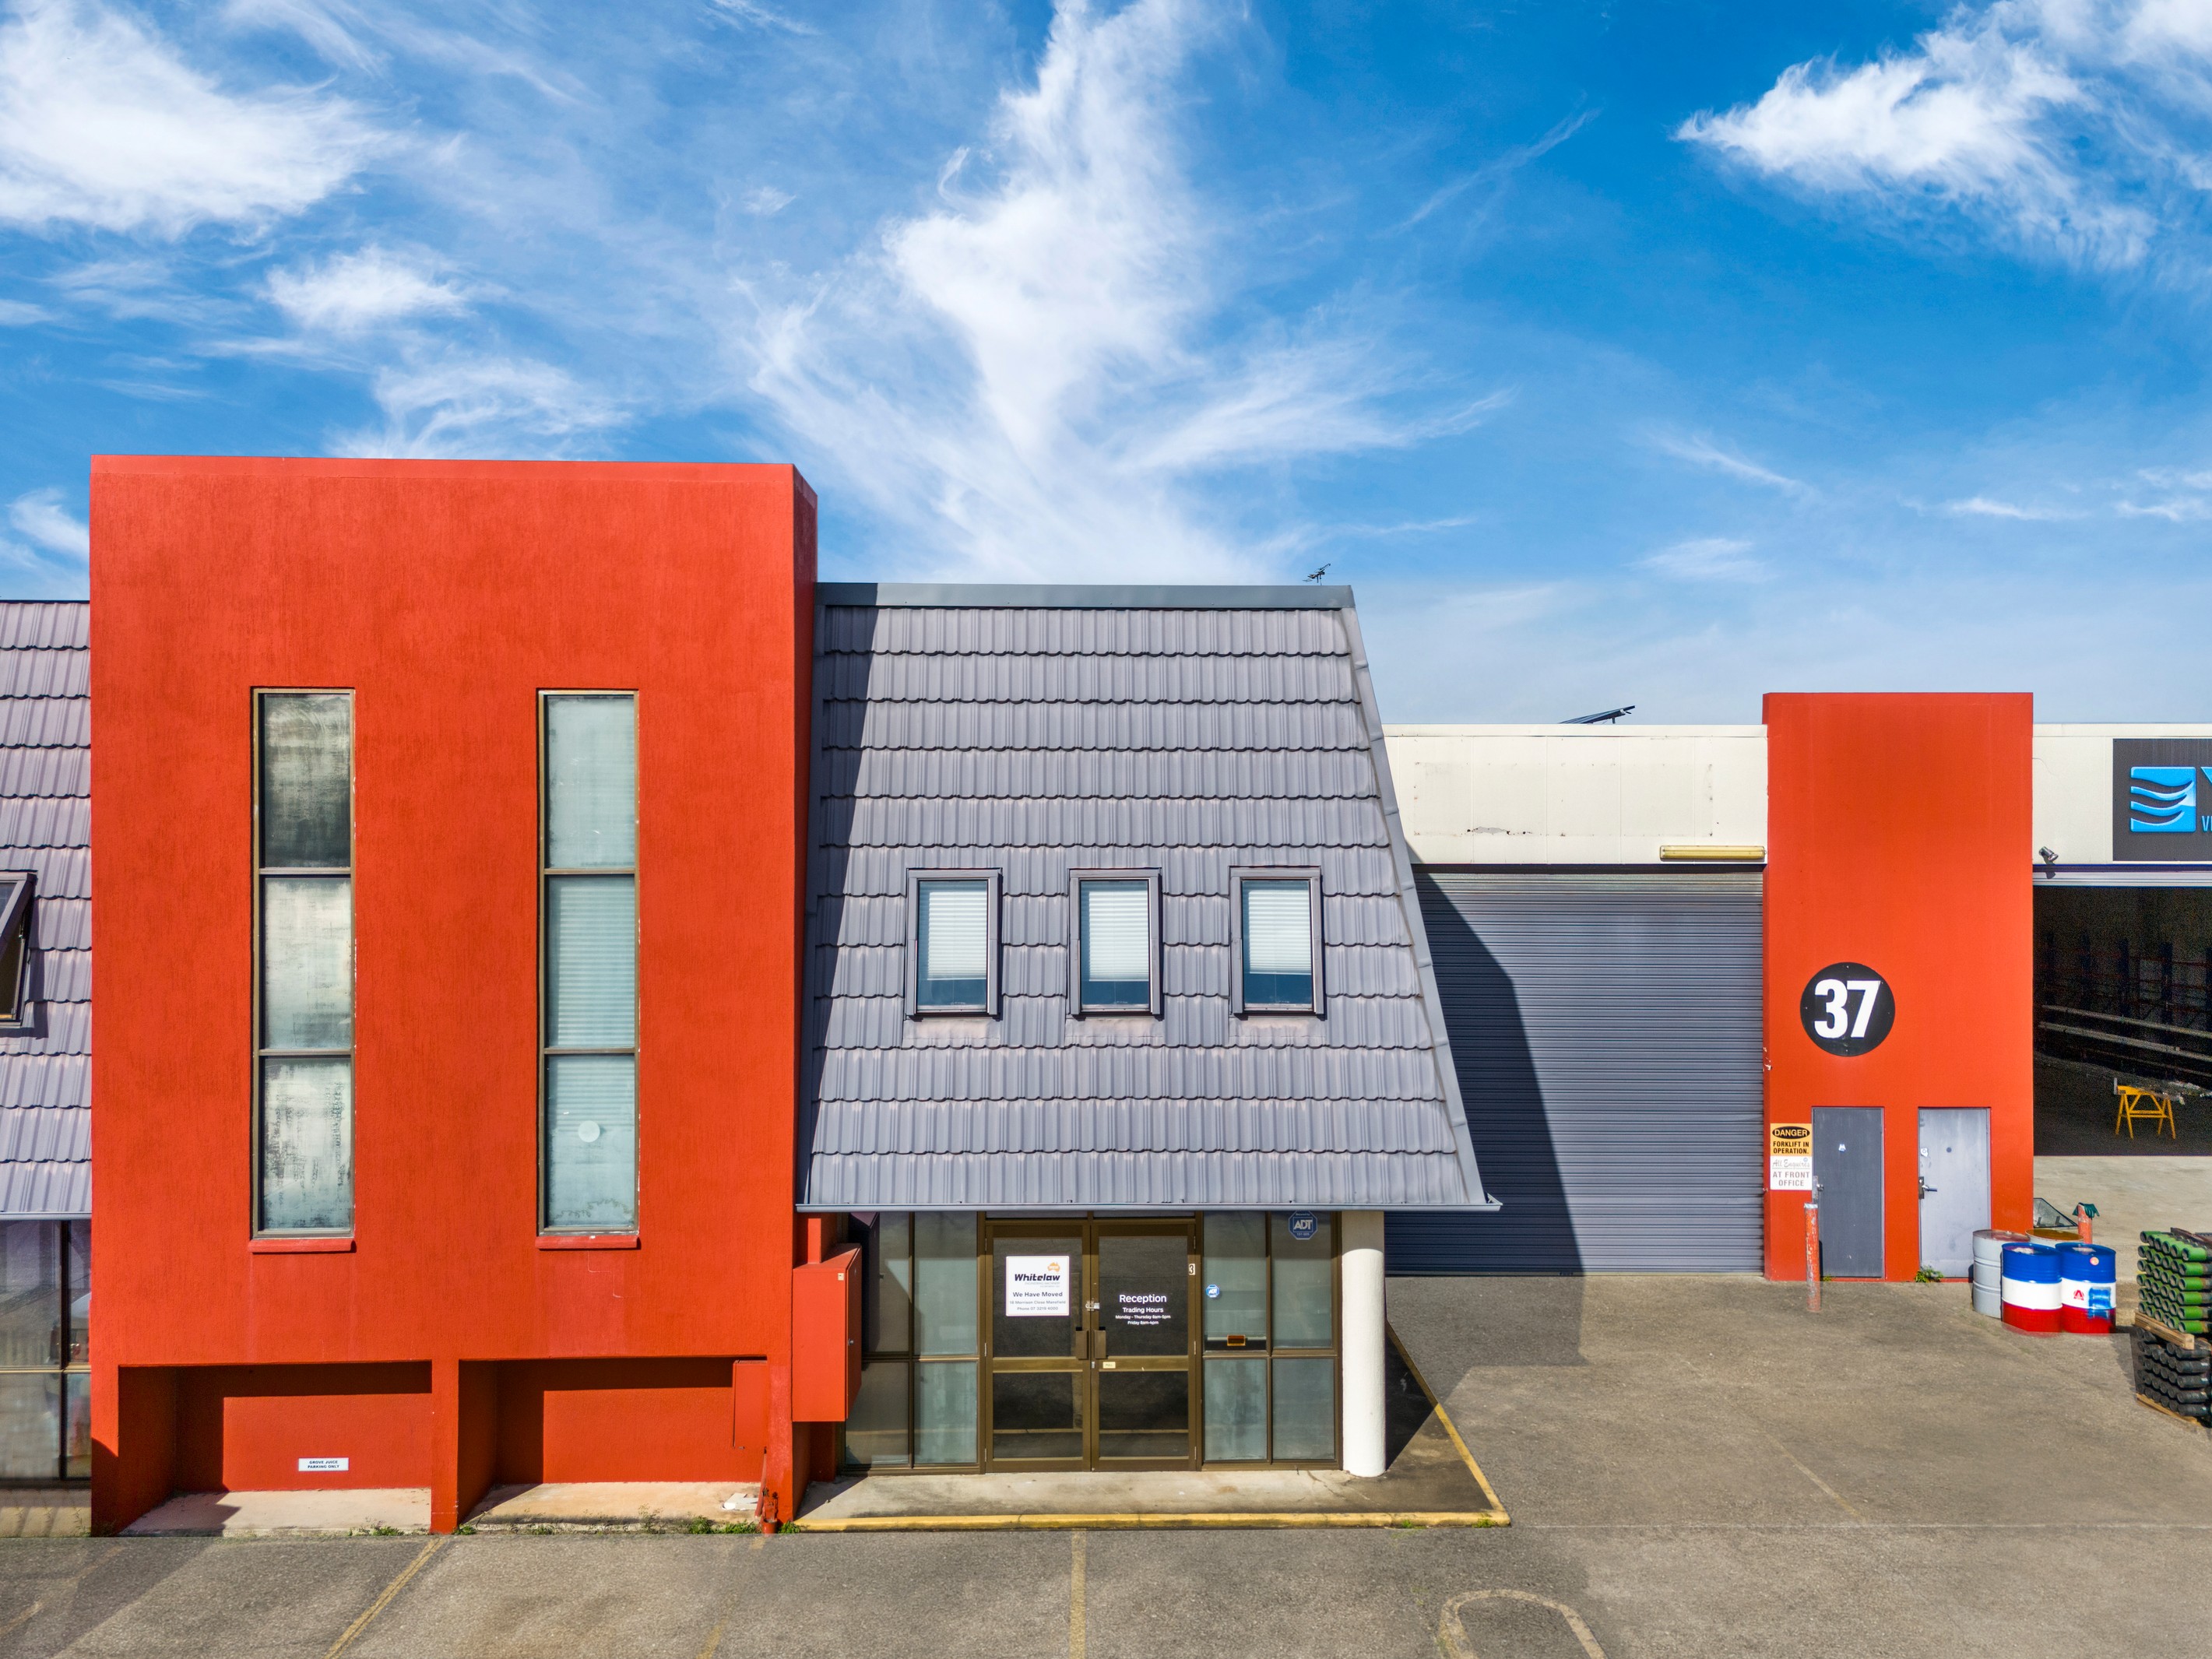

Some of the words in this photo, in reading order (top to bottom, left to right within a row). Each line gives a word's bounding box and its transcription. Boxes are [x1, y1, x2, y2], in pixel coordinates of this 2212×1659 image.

[1814, 979, 1880, 1039] 37
[1293, 1219, 1313, 1230] ADT
[1189, 1264, 1194, 1274] 3
[1120, 1294, 1167, 1304] Reception
